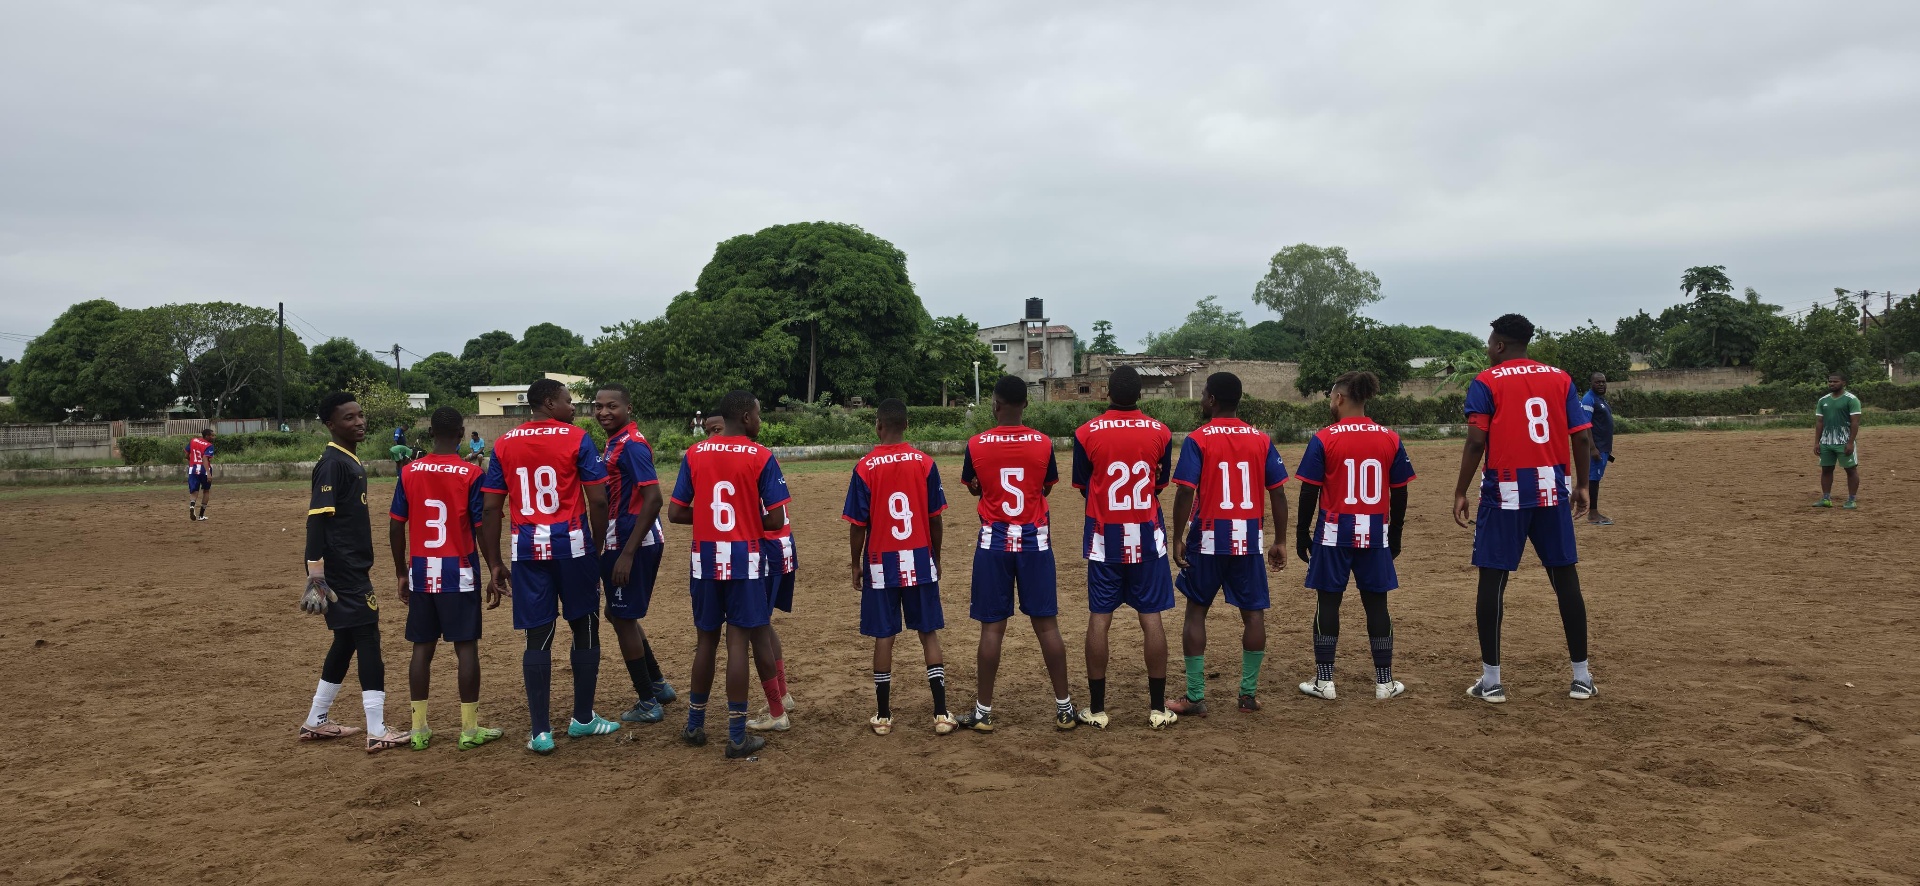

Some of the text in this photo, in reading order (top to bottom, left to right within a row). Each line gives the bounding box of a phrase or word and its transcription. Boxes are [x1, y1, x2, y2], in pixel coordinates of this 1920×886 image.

[1492, 364, 1562, 379] Sinocare
[1090, 418, 1162, 433] Sinocare
[1328, 422, 1390, 435] Sinocare
[1524, 396, 1550, 444] 8
[504, 425, 570, 440] Sinocare
[978, 432, 1043, 445] Sinocare
[1202, 425, 1262, 437] Sinocare
[695, 440, 758, 456] Sinocare
[410, 461, 470, 477] Sinocare
[864, 450, 924, 471] Sinocare
[515, 465, 560, 516] 18
[999, 467, 1025, 517] 5
[1106, 460, 1152, 511] 22
[1218, 461, 1254, 510] 11
[1343, 458, 1383, 505] 10
[710, 480, 737, 532] 6
[887, 491, 914, 541] 9
[424, 498, 448, 549] 3
[614, 586, 623, 601] 4
